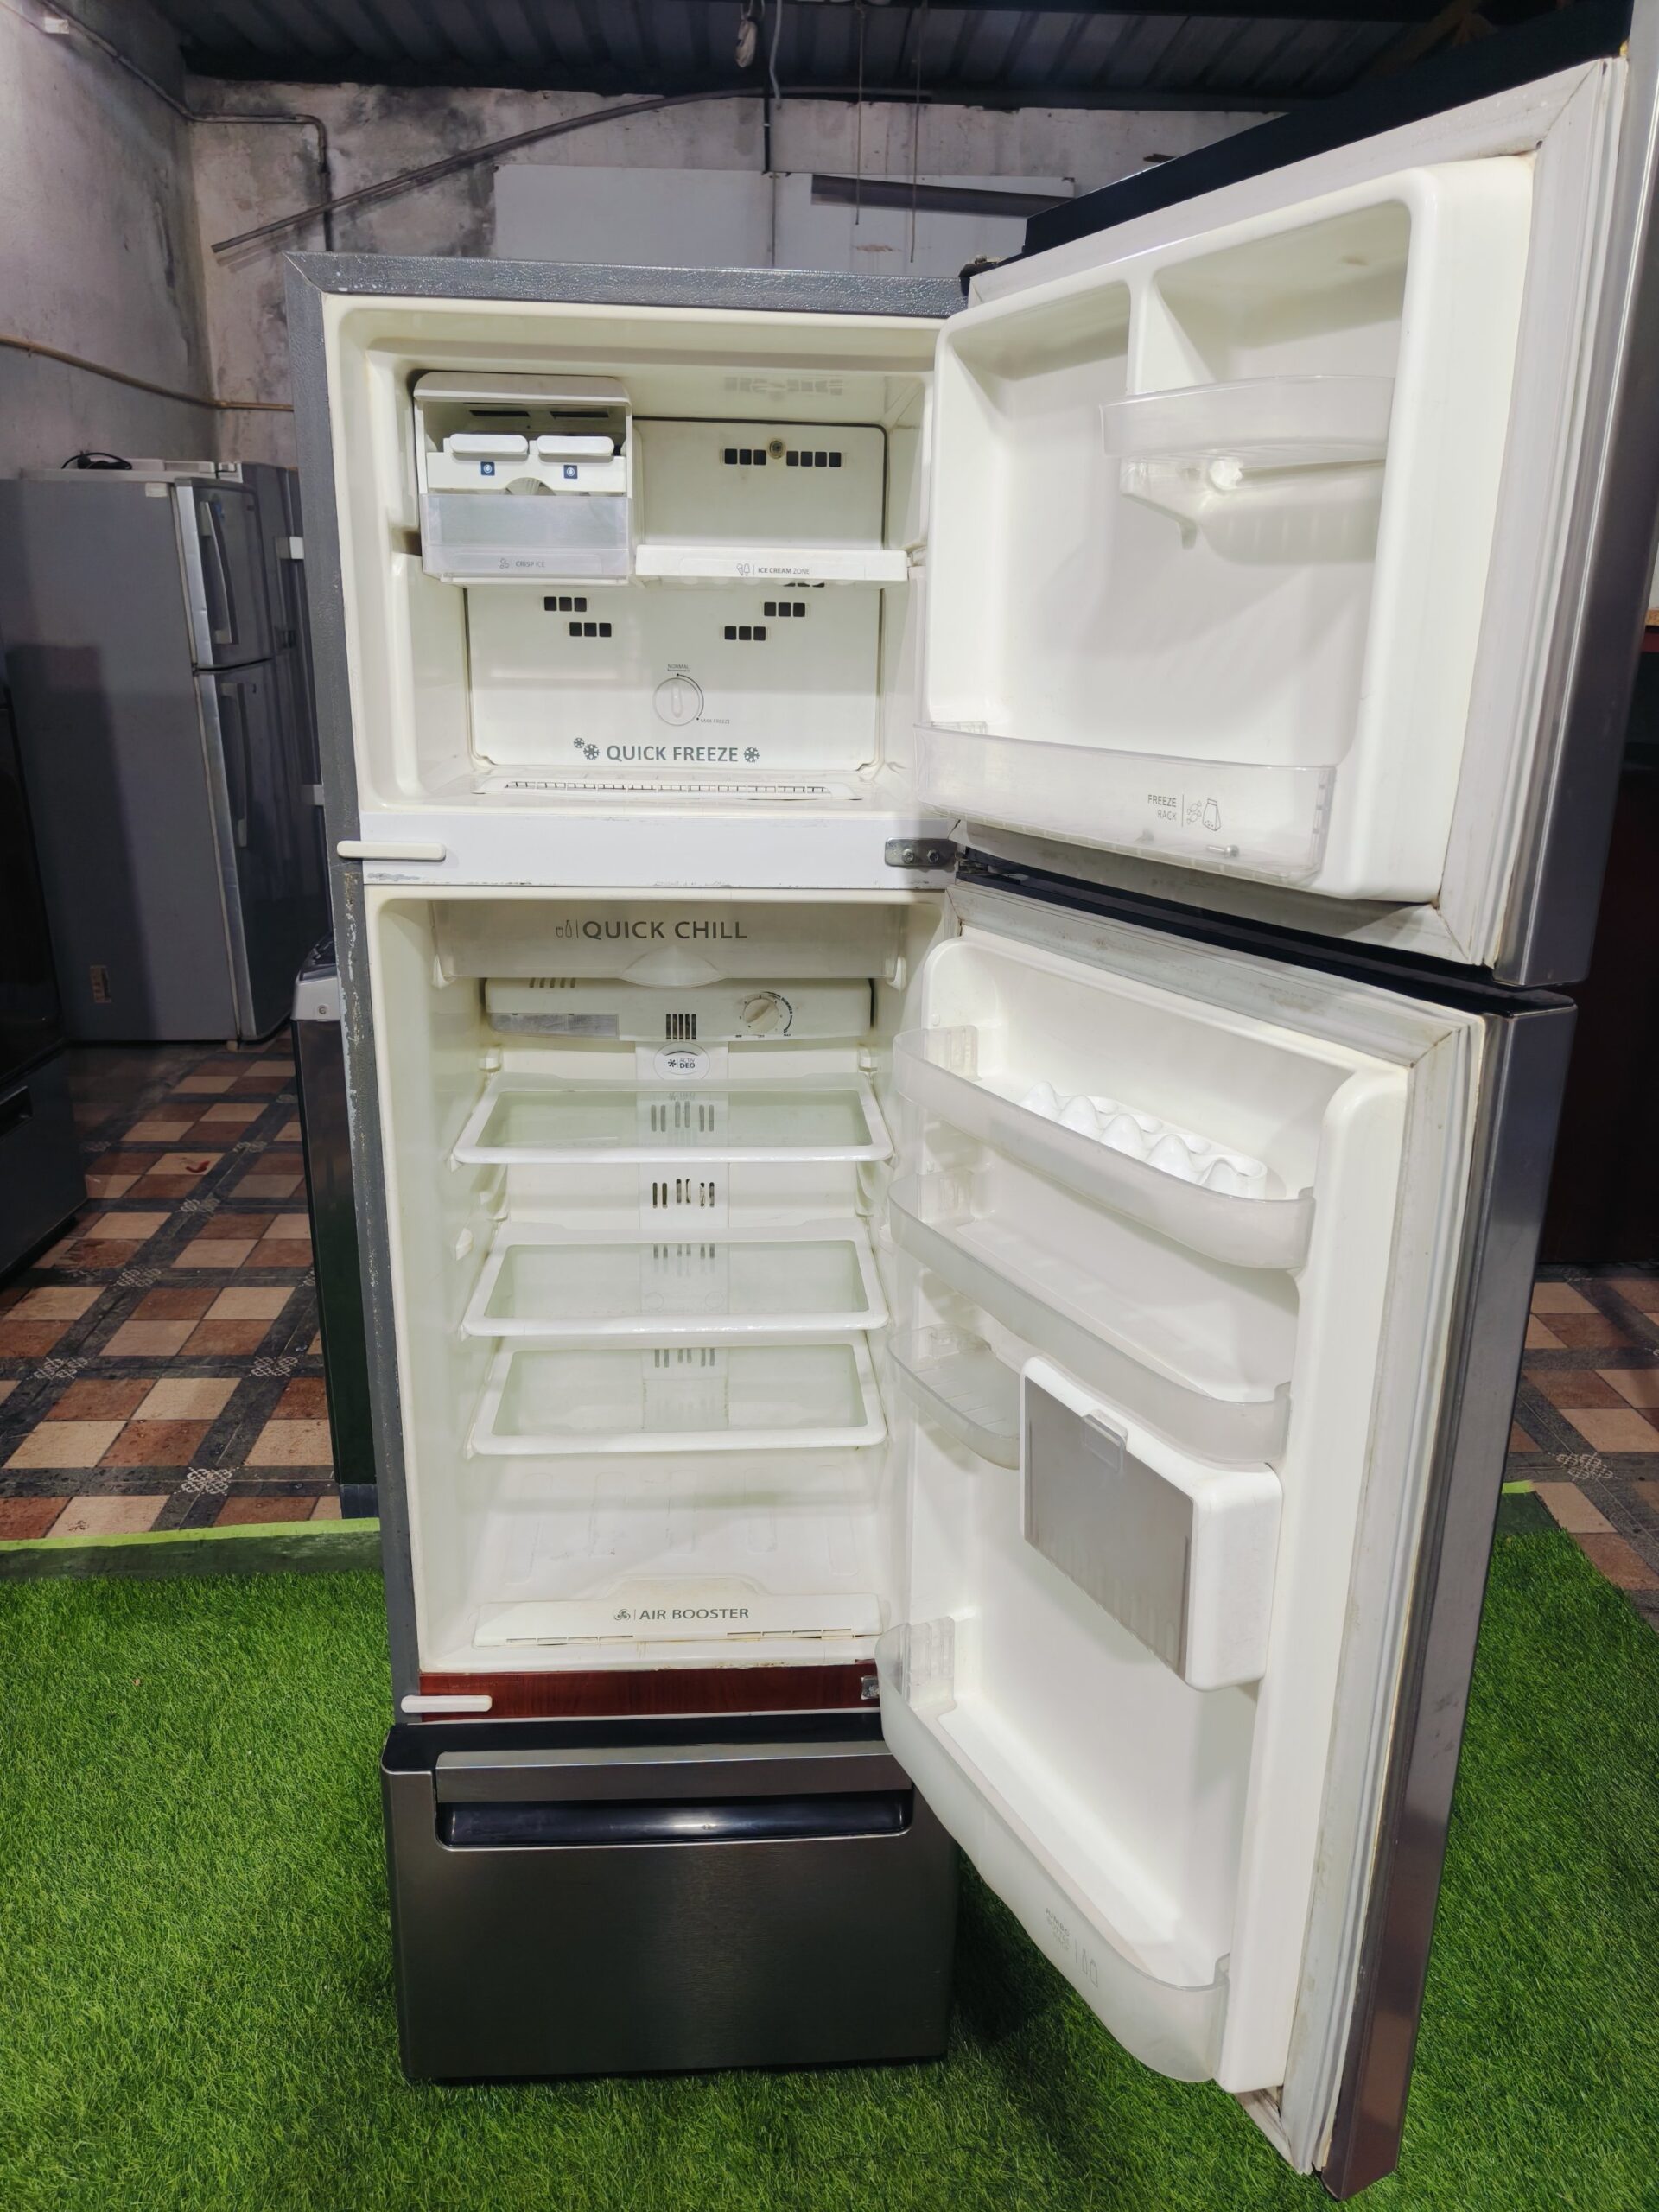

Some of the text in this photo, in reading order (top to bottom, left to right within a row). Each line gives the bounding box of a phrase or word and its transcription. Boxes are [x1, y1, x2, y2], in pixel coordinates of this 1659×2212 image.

[606, 745, 739, 762] QUICK FREEZE
[1147, 794, 1176, 807] FREEZE
[1157, 809, 1176, 821] RACK
[582, 921, 747, 940] QUICK CHILL
[639, 1608, 749, 1620] AIR BOOSTER
